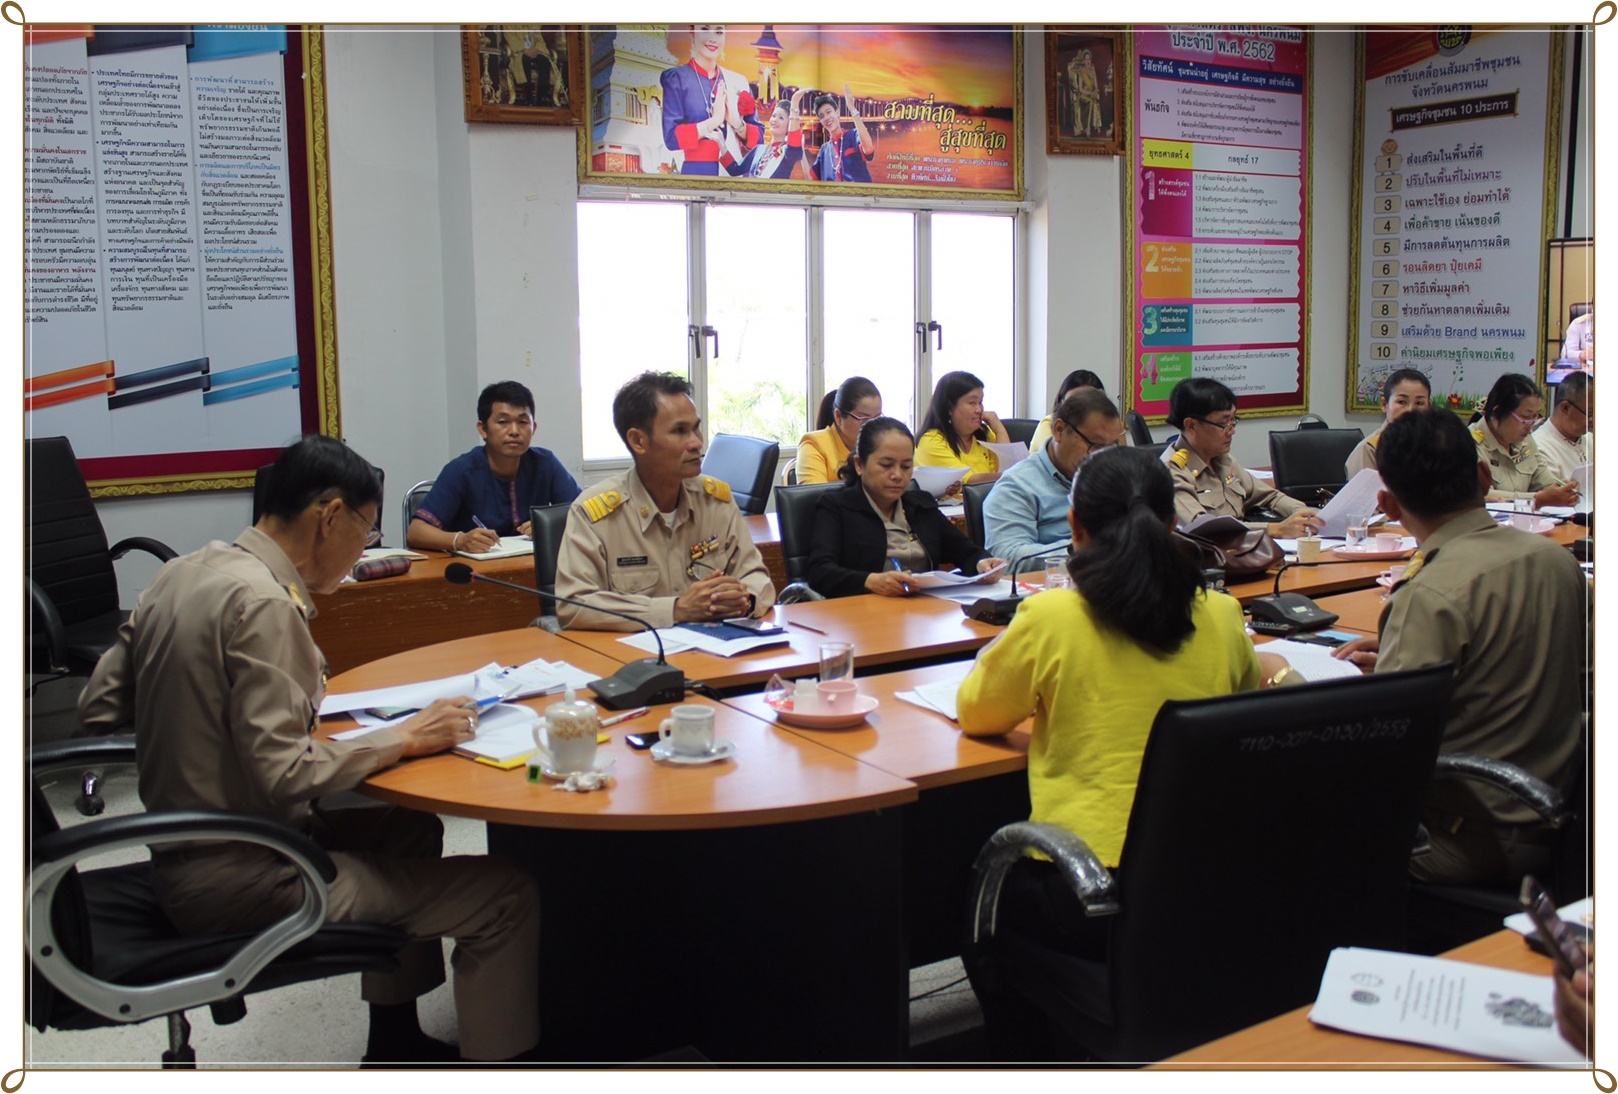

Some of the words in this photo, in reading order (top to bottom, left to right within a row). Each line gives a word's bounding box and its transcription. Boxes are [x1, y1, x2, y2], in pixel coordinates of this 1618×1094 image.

[1172, 32, 1213, 51] ประจำปี
[1218, 39, 1241, 55] พ.ศ.
[1243, 40, 1275, 60] 2562
[1142, 59, 1174, 74] วิสัยทัศน์
[1212, 71, 1240, 83] เศรษฐกิจดี
[1385, 55, 1520, 85] การขับเคลื่อนสัมมาชีพชุมชน
[228, 85, 246, 94] รายได้
[247, 88, 280, 97] และคุณภาพ
[1412, 78, 1488, 98] จังหวัดนครพนม
[197, 103, 235, 113] อย่างต่อเนื่อง
[1144, 100, 1170, 113] พันธกิจ
[1396, 104, 1457, 124] เศรษฐกิจชุมชน
[1460, 104, 1472, 114] 10
[1475, 100, 1509, 114] ประการ
[101, 127, 122, 136] มากขึ้น
[940, 119, 1007, 155] สู่สุขที่สุด
[1149, 149, 1183, 160] ยุทธศาสตร์
[1228, 154, 1249, 165] กลยุทธ์
[1386, 158, 1392, 168] 1
[1406, 143, 1483, 165] ส่งเสริมในพื้นที่ดี
[1145, 171, 1155, 200] 1
[1385, 178, 1392, 190] 2
[1406, 168, 1501, 187] ปรับในพื้นที่ไม่เหมาะ
[1384, 200, 1392, 211] 3
[1405, 193, 1460, 208] เฉพาะใช้เอง
[1464, 189, 1511, 205] ย่อมทำได้
[1384, 221, 1391, 232] 4
[1404, 215, 1451, 230] เพื่อค้าขาย
[1455, 213, 1500, 227] เน้นของดี
[1383, 242, 1391, 253] 5
[1403, 236, 1510, 252] มีการลดต้นทุนการผลิต
[1145, 245, 1159, 273] 2
[1382, 264, 1390, 275] 6
[1403, 261, 1446, 273] รอนลิดยา
[1450, 258, 1482, 275] ปุ๋ยเคมี
[1382, 284, 1389, 295] 7
[1402, 279, 1470, 298] หาวิธีเพิ่มมูลค่า
[1381, 304, 1389, 315] 8
[1402, 300, 1510, 316] ช่วยกันหาตลาดเพิ่มเติม
[1144, 306, 1158, 335] 3
[1381, 324, 1388, 335] 9
[1402, 325, 1441, 338] เสริมด้วย
[1445, 326, 1477, 337] Brand
[1481, 329, 1525, 338] นครพนม
[1377, 347, 1391, 358] 10
[1401, 347, 1514, 361] ค่านิยมเศรษฐกิจพอเพียง
[1143, 355, 1158, 385] 4
